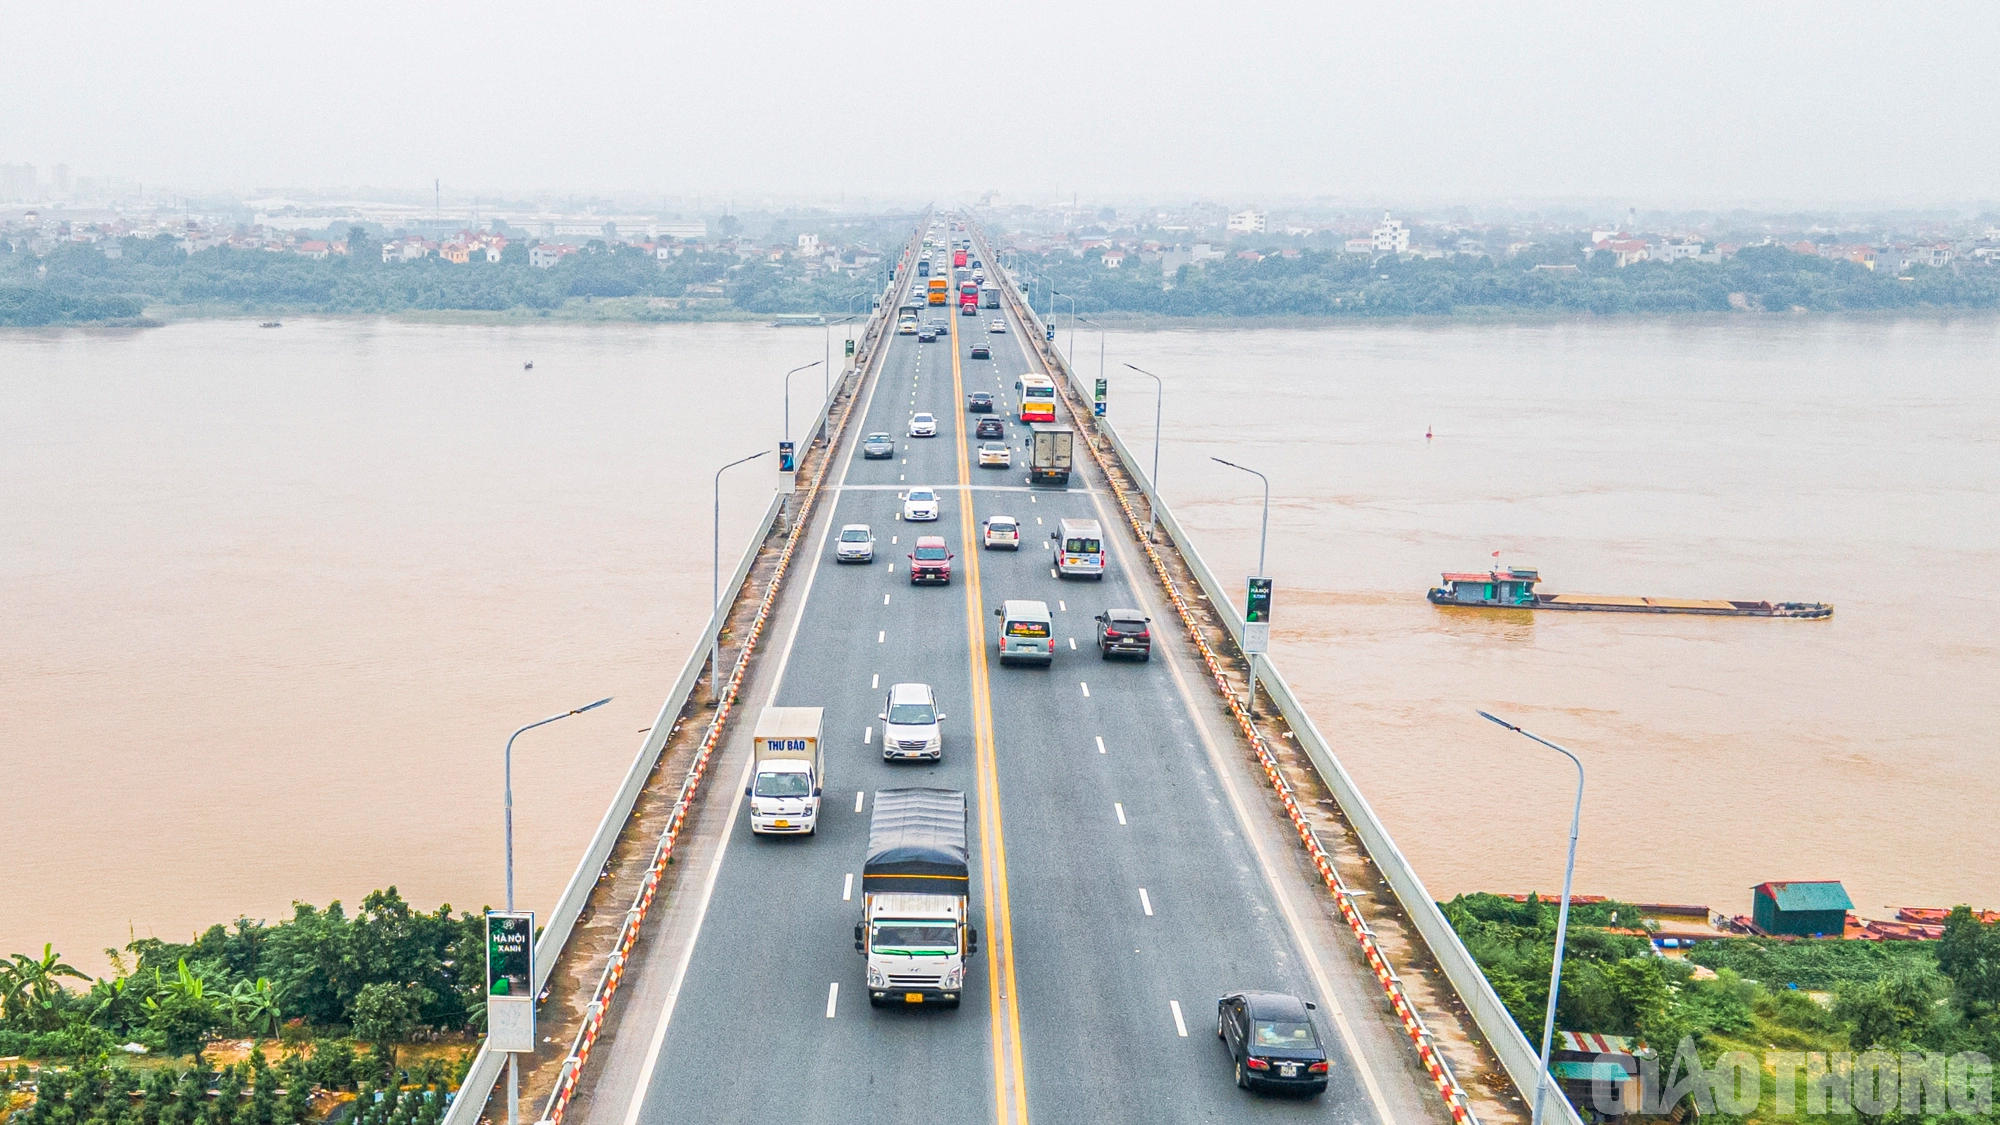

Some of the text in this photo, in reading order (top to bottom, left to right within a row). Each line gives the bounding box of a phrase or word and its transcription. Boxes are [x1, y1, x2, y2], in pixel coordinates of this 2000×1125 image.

[767, 739, 786, 751] THƯ
[493, 932, 525, 944] HÀ NỘI
[498, 944, 521, 952] XANH
